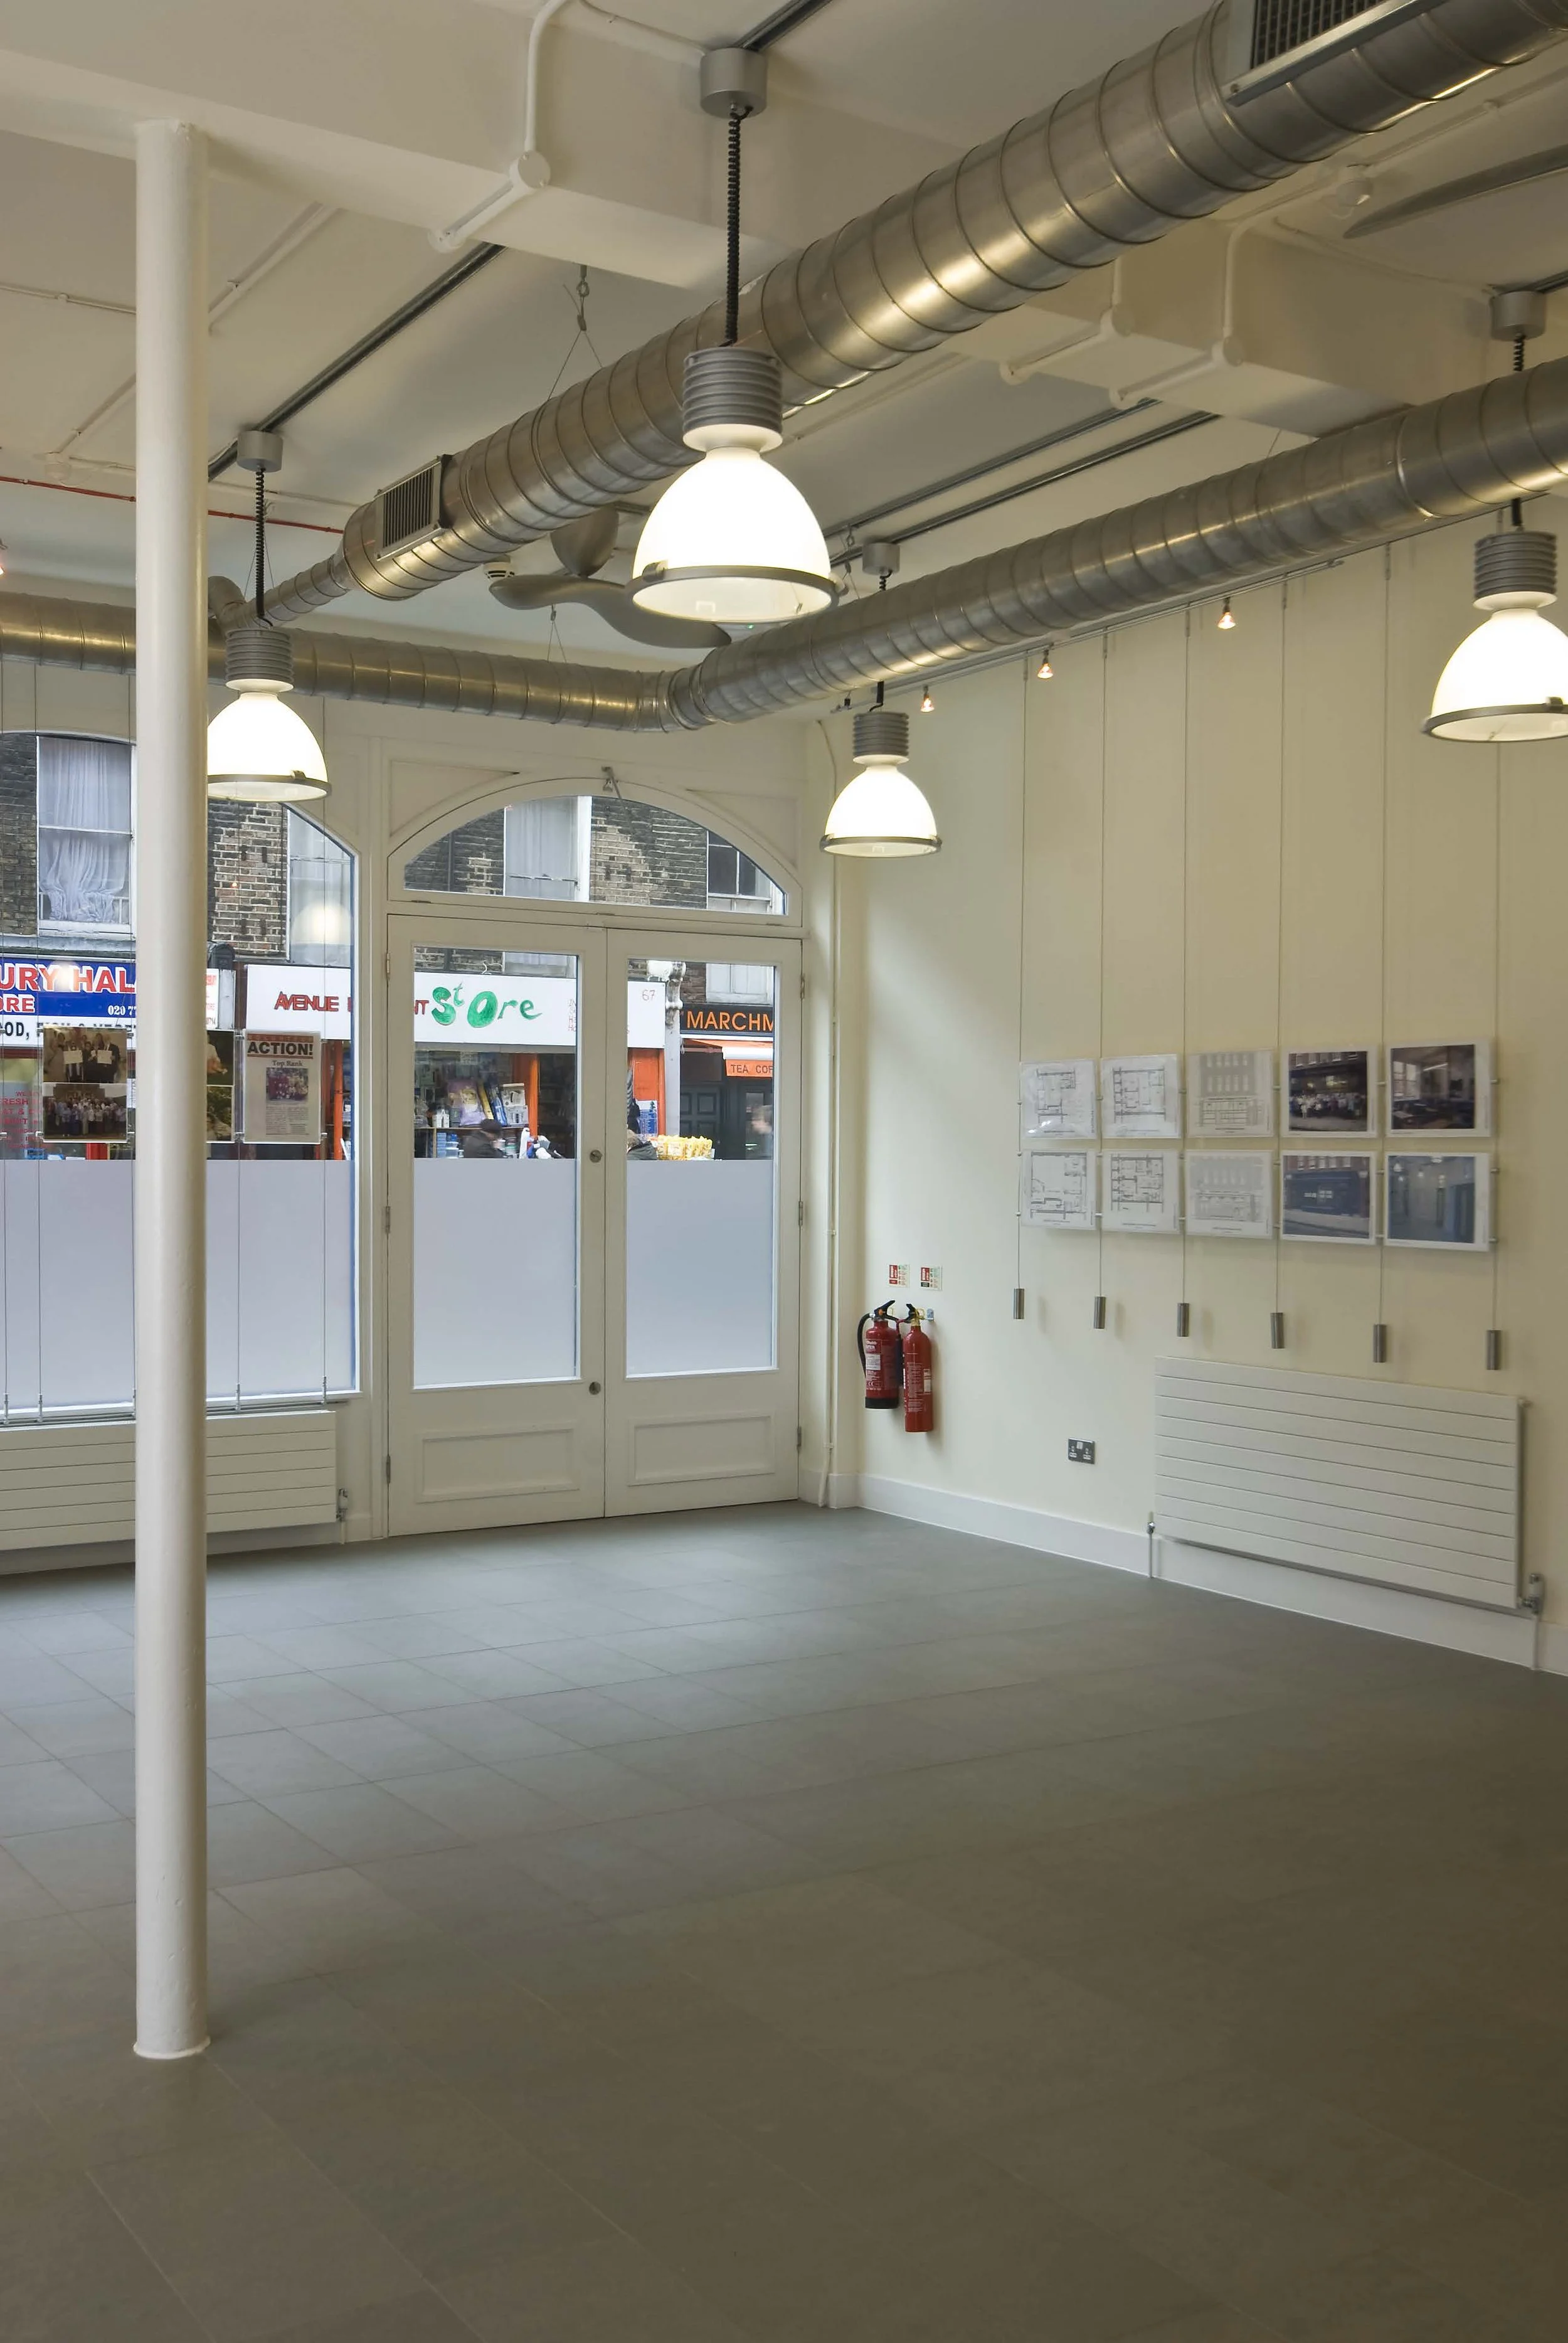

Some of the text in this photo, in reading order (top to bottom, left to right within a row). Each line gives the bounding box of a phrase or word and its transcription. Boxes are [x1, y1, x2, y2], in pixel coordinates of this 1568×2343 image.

[642, 989, 655, 1001] 67
[273, 991, 339, 1012] AVENUE
[107, 1005, 126, 1016] 020
[247, 1041, 313, 1055] ACTION!
[731, 1064, 749, 1073] TEA
